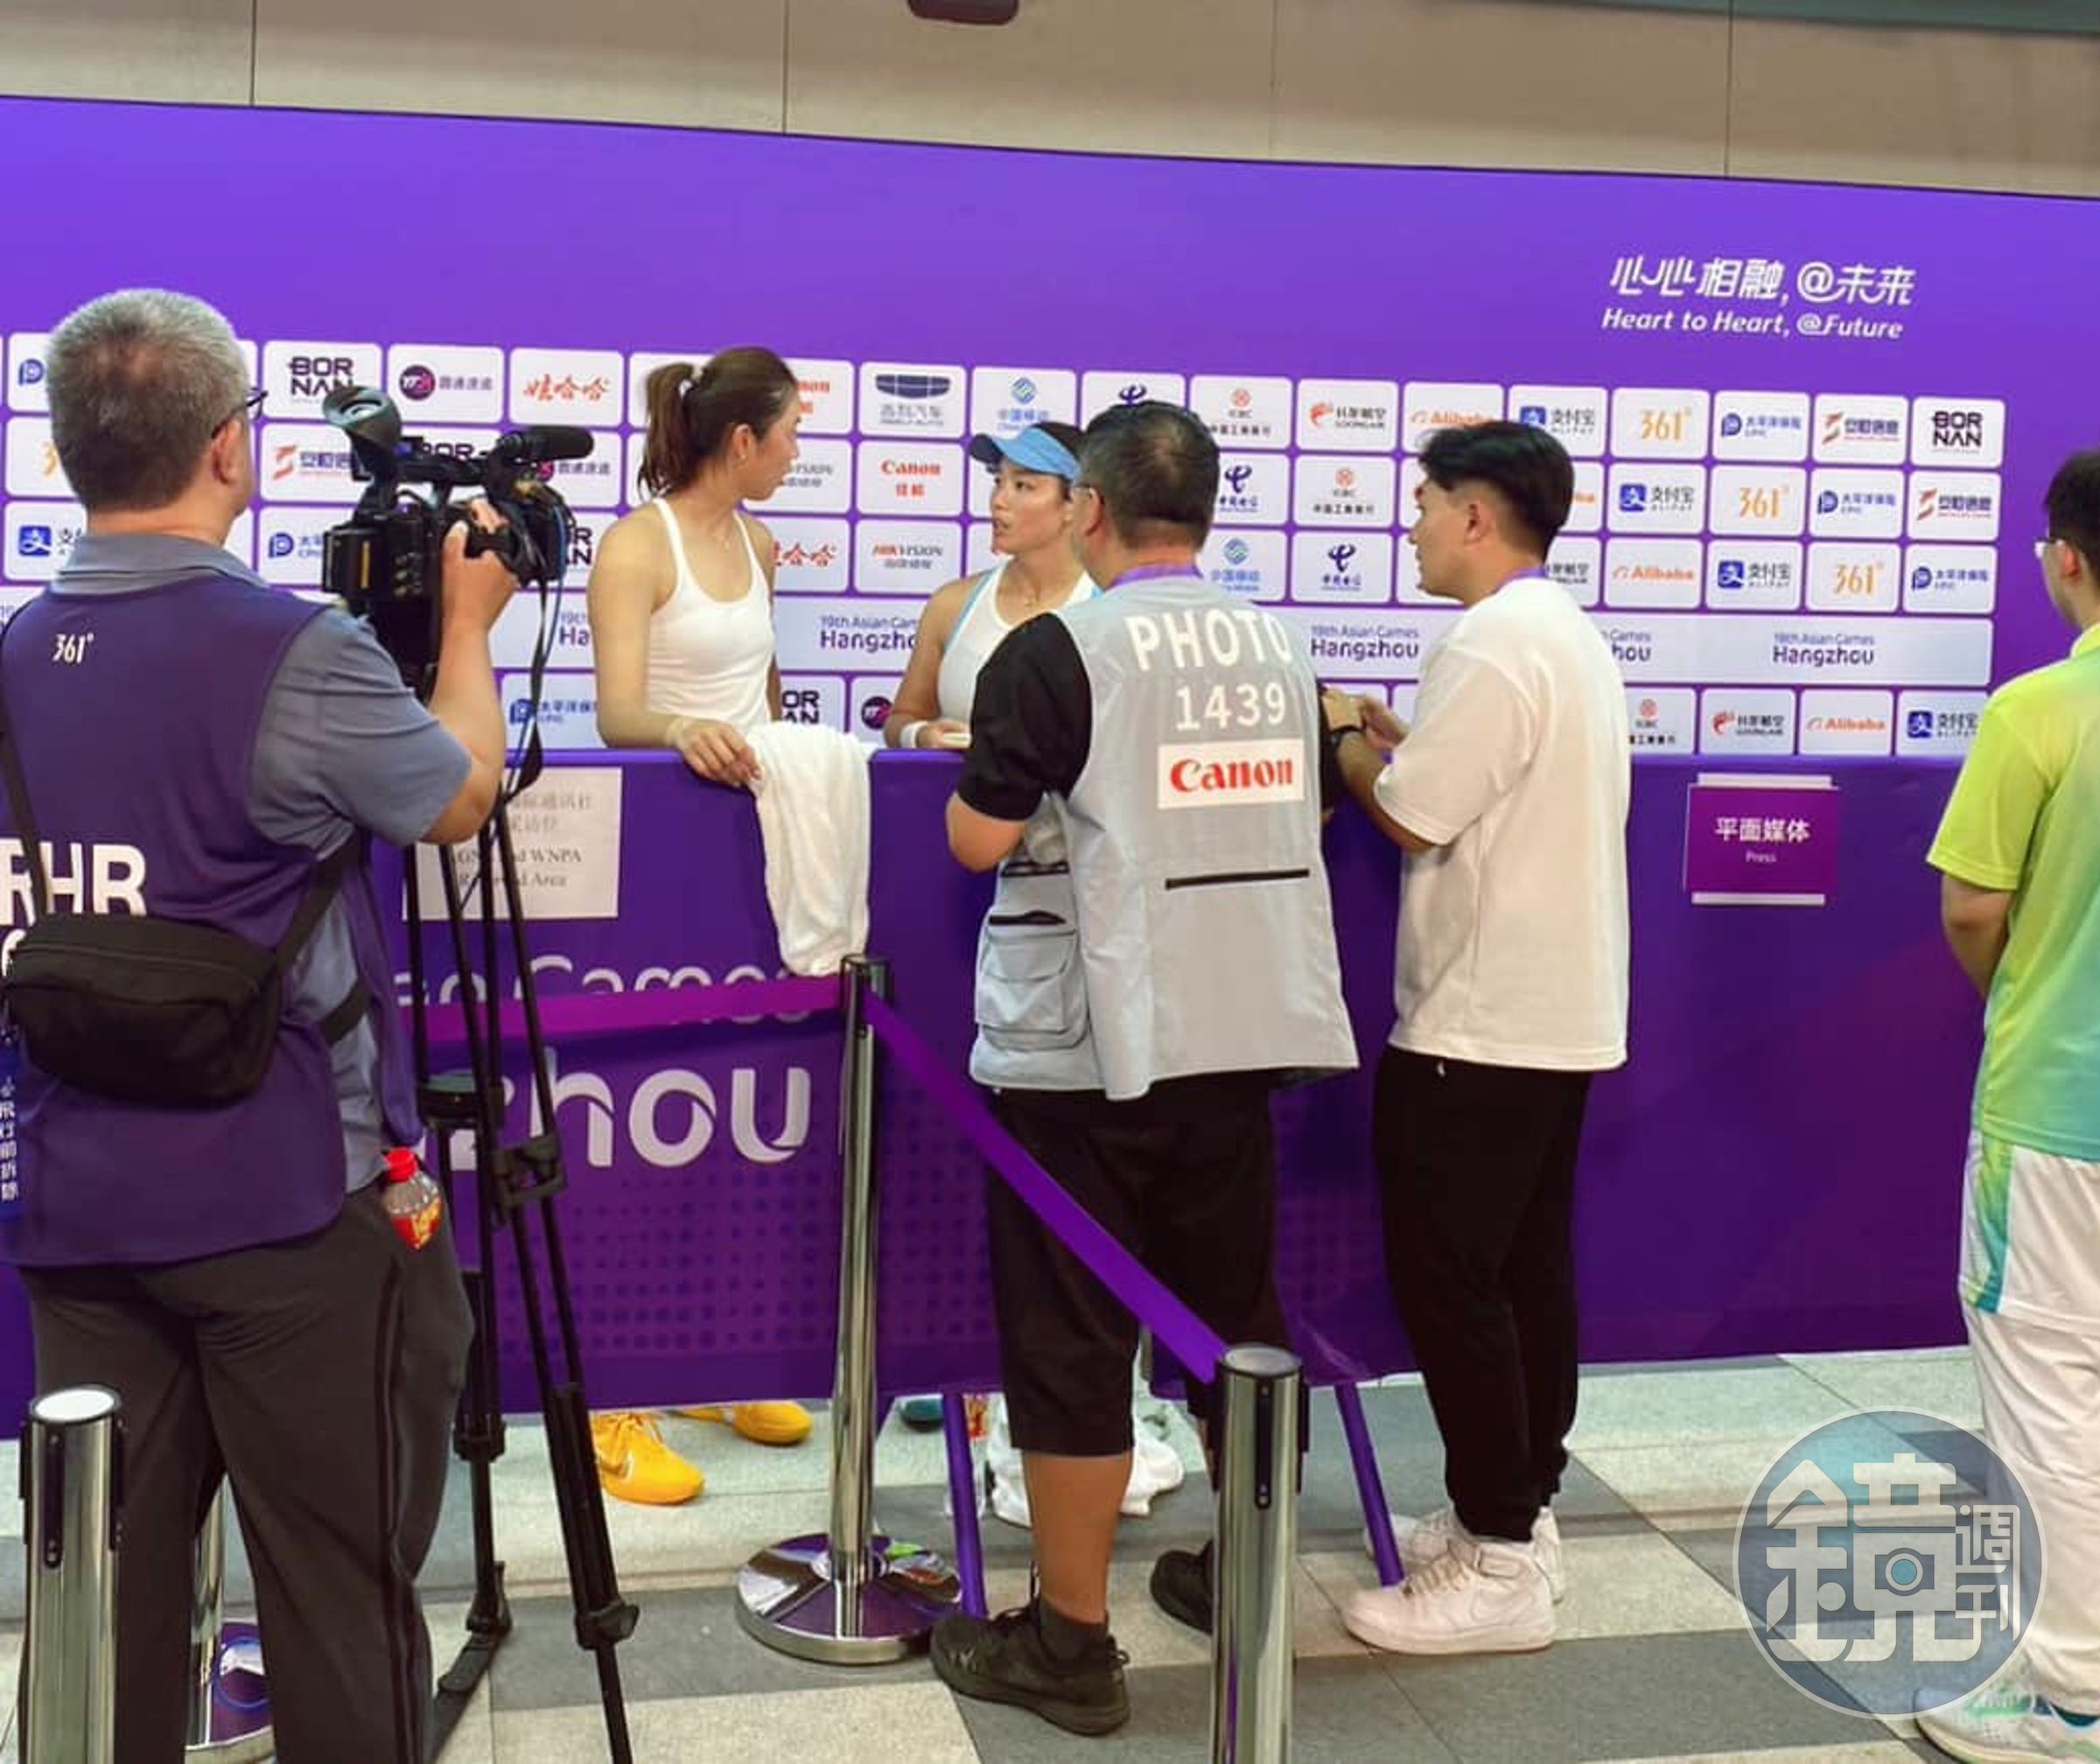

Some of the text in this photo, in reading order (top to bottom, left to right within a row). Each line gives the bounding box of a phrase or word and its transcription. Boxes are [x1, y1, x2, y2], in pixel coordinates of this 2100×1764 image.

[1601, 307, 1904, 340] Heart to Heart, @Future
[289, 356, 354, 377] BOR
[1932, 410, 1984, 430] BOR
[1933, 430, 1983, 447] NAN
[880, 458, 942, 476] Canon
[1631, 564, 1696, 582] Alibaba
[1124, 607, 1293, 671] PHOTO
[1311, 639, 1419, 662] Hangzhou
[1772, 646, 1875, 668] Hangzhou
[781, 690, 820, 709] OR
[1175, 682, 1287, 732] 1439
[1824, 717, 1886, 732] Alibaba
[1170, 758, 1294, 794] Canon
[1714, 816, 1810, 844] 平面媒体
[1745, 850, 1777, 863] Press
